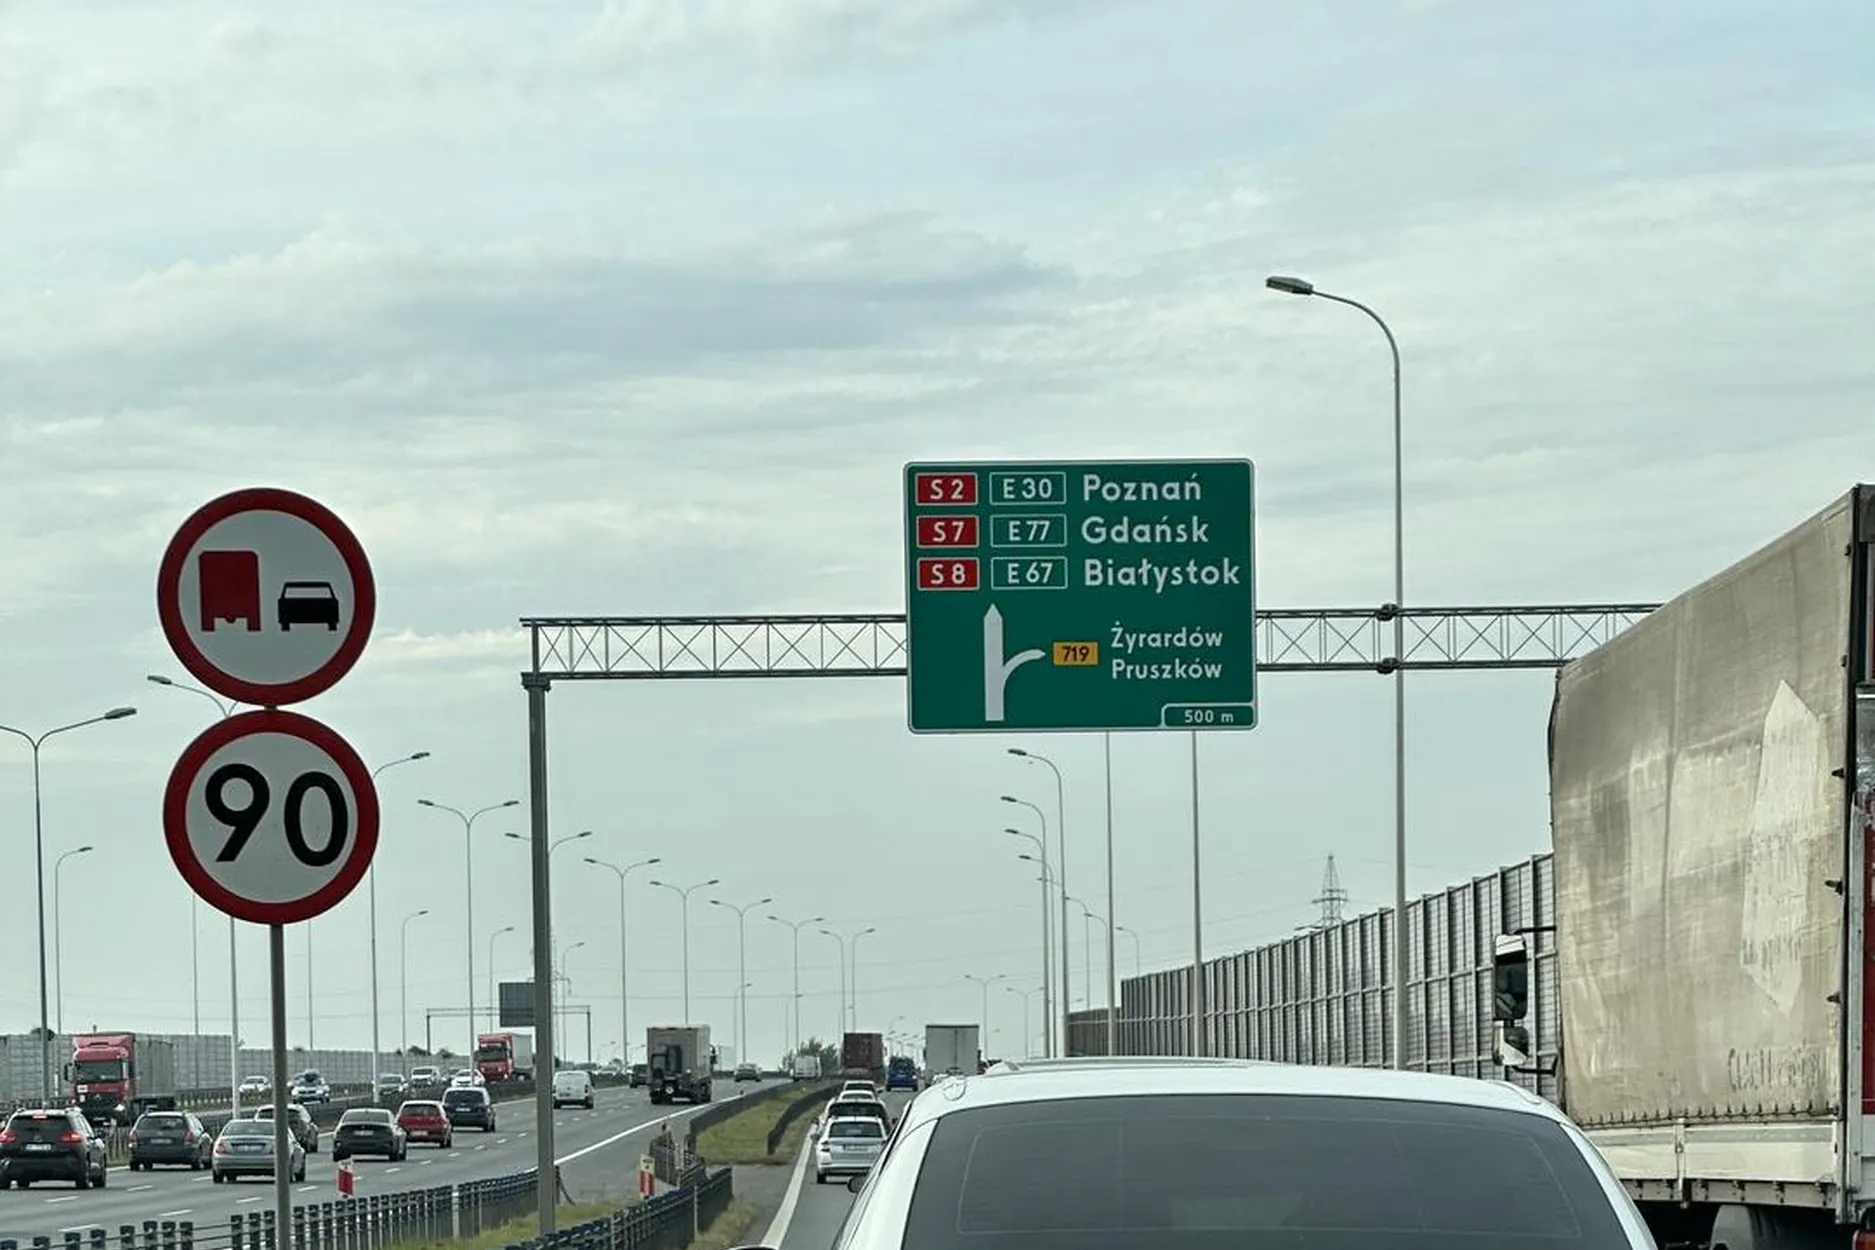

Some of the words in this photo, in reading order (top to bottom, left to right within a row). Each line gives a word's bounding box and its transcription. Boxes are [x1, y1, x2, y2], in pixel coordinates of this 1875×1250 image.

[1083, 472, 1201, 502] Poznań
[1081, 515, 1209, 544] Gdańsk
[1084, 557, 1240, 594] Białystok
[1110, 620, 1223, 654] Żyrardów
[1061, 645, 1090, 663] 719
[1112, 657, 1222, 680] Pruszków
[1183, 708, 1214, 724] 500
[1220, 712, 1234, 723] m
[204, 762, 349, 868] 90
